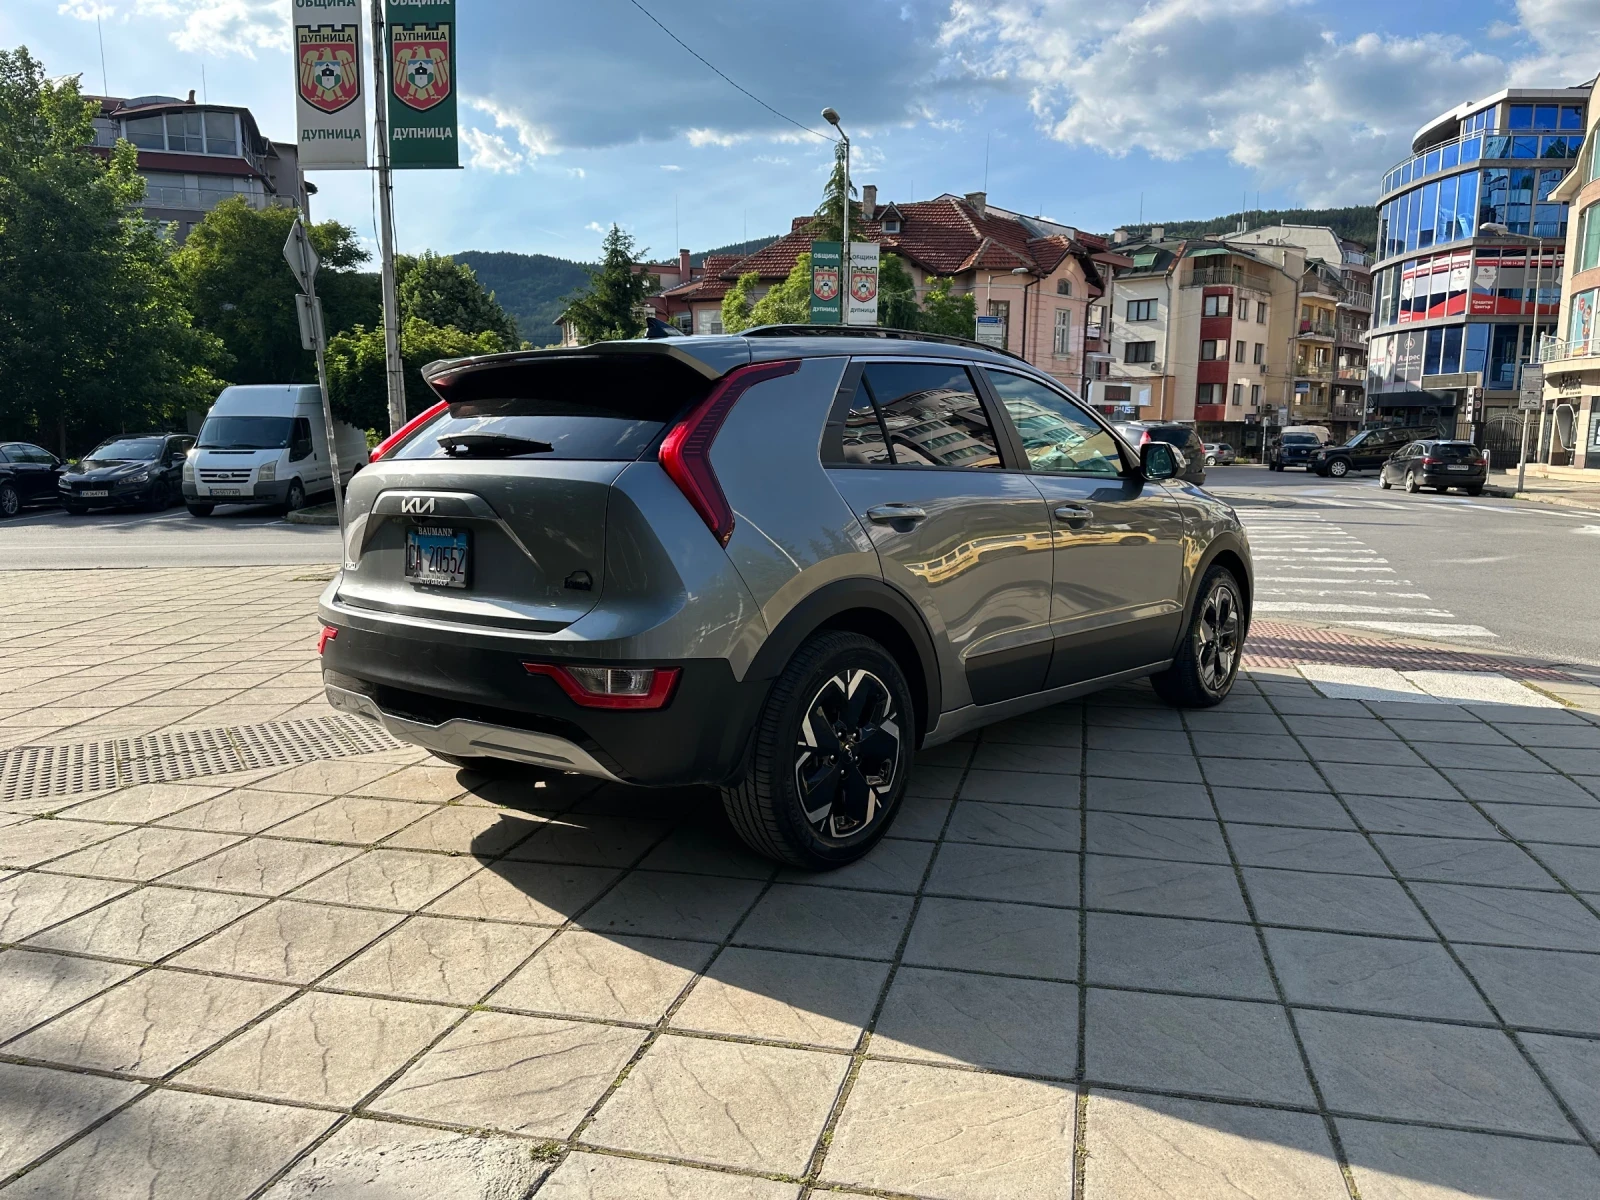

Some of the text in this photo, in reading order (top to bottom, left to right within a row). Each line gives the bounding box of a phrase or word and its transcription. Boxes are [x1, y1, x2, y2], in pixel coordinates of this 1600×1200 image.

[296, 0, 356, 9] ОБЩИНА
[300, 33, 354, 43] ДУПНИЦА
[394, 31, 447, 41] ДУПНИЦА
[302, 128, 361, 142] ДУПНИЦА
[393, 127, 452, 140] ДУПНИЦА
[402, 498, 435, 513] KIA
[418, 527, 452, 536] BAUMANN
[409, 544, 465, 575] CA 20552
